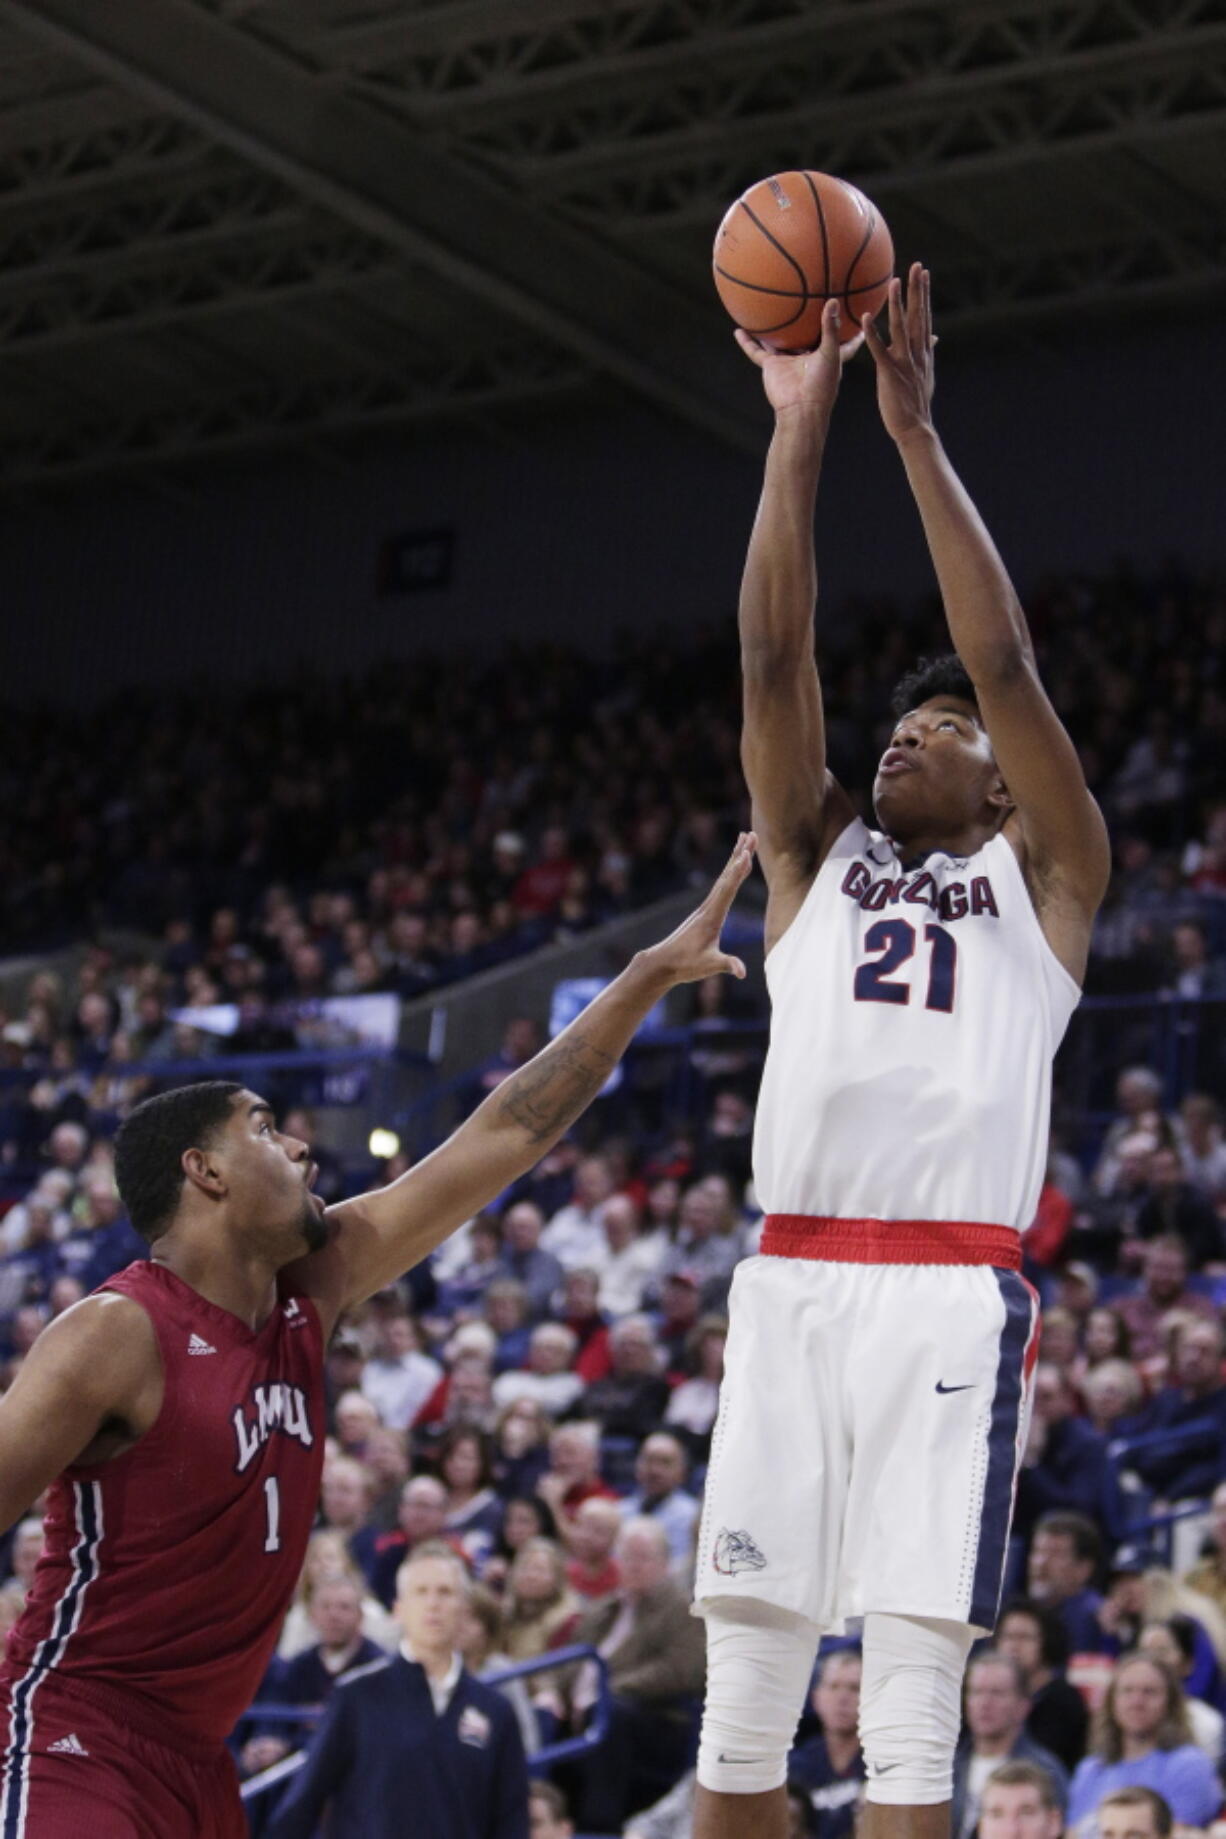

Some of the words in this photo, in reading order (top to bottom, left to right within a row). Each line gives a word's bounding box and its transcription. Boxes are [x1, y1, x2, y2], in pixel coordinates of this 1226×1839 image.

[854, 918, 957, 1014] 21
[232, 1382, 314, 1474] LMU
[264, 1475, 280, 1553] 1
